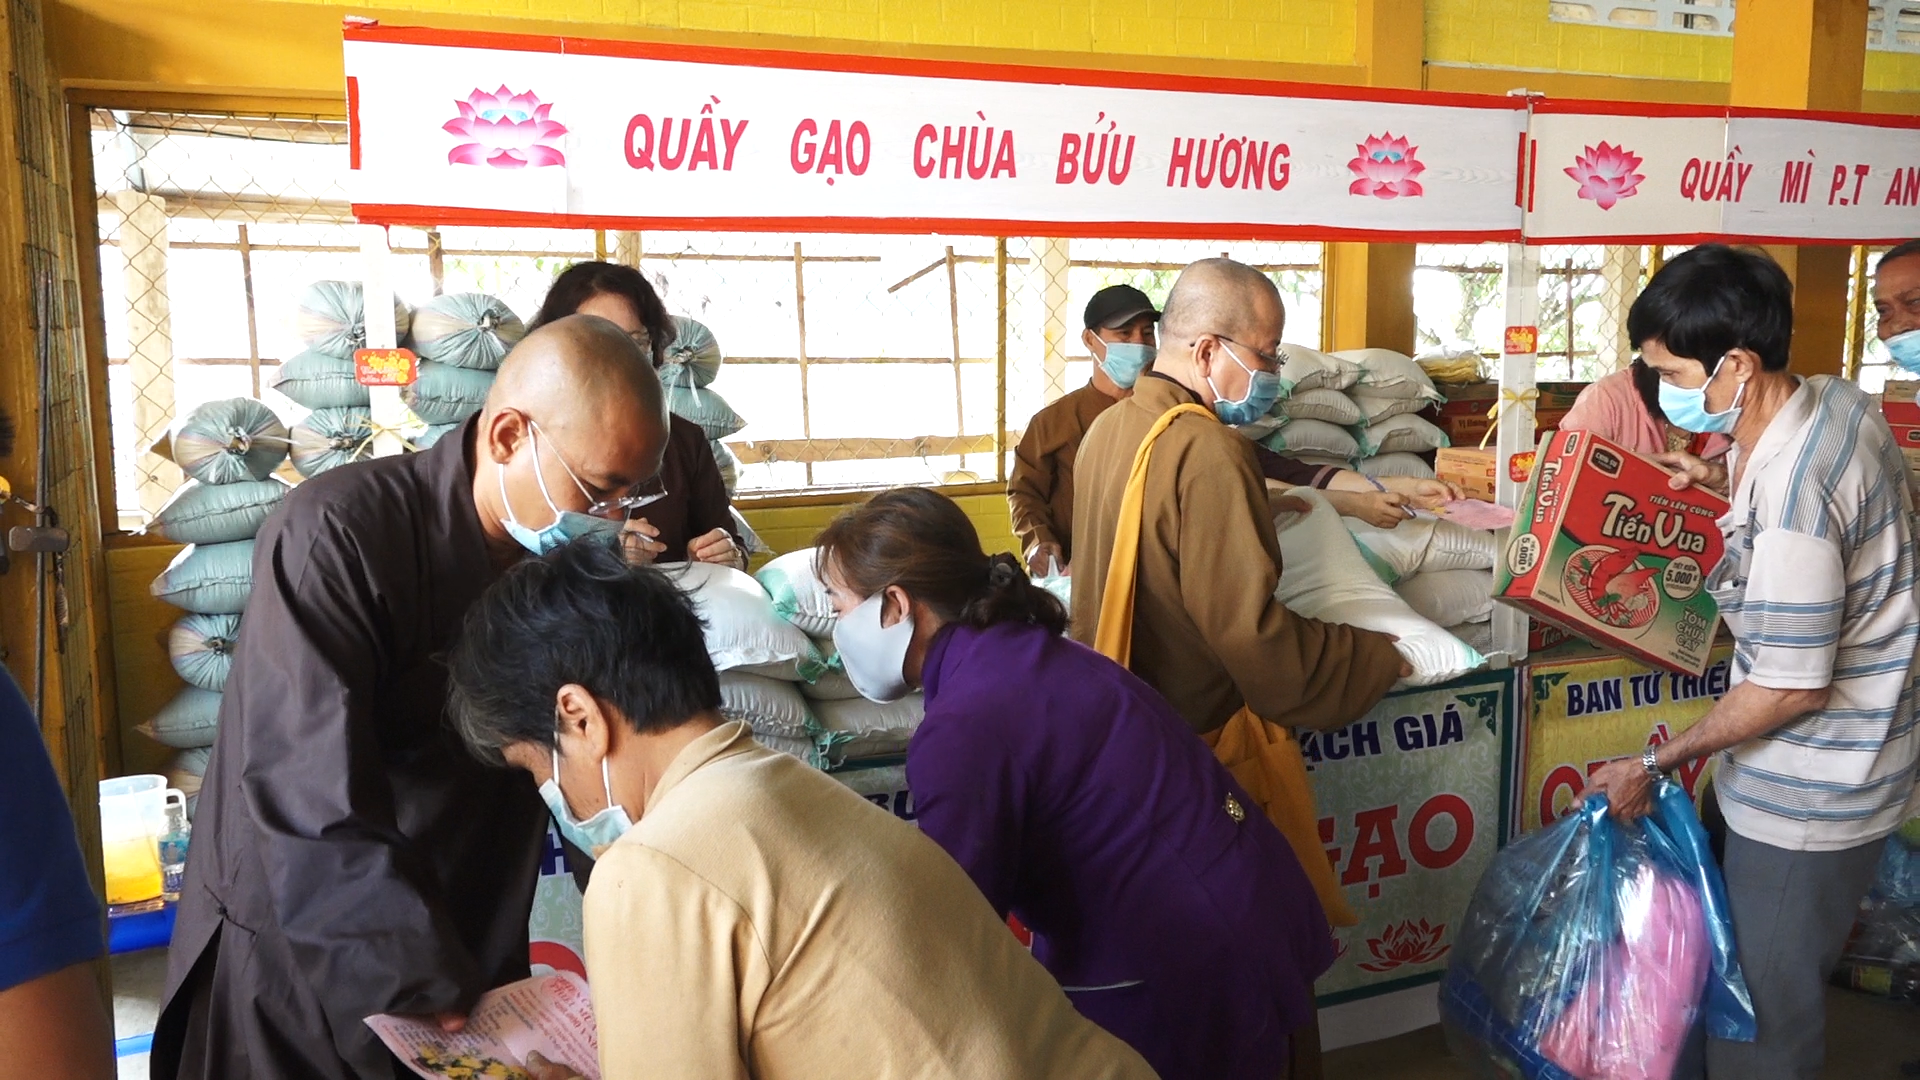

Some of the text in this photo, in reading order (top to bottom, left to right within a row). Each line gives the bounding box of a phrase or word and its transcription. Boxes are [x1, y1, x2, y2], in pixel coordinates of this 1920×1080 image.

[624, 95, 749, 172] QUẦY
[790, 118, 871, 186] GẠO
[913, 110, 1017, 180] CHÙA
[1166, 132, 1291, 191] HƯƠNG
[1680, 145, 1753, 203] QUẦY
[1780, 149, 1816, 204] MÌ
[1602, 492, 1652, 544] Tiến
[1654, 511, 1705, 554] Vua
[1666, 570, 1693, 585] 5.000
[1567, 678, 1624, 717] BAN
[1669, 660, 1731, 702] THIỆ
[1393, 703, 1464, 753] GIÁ
